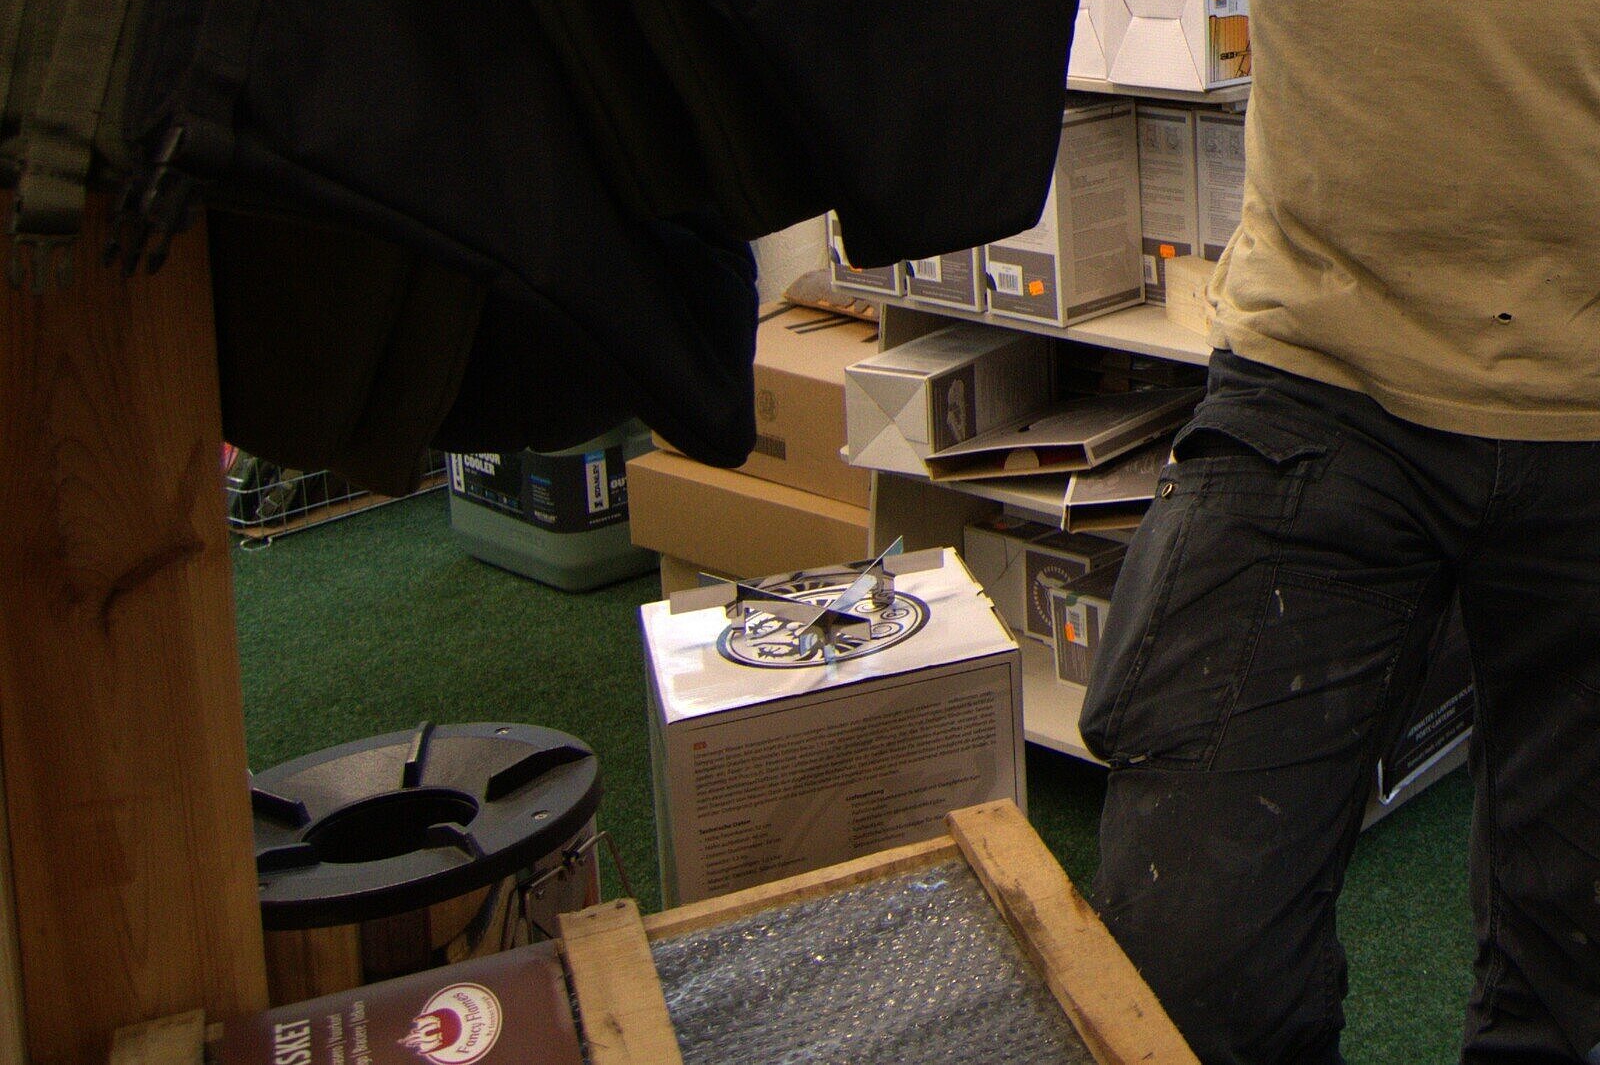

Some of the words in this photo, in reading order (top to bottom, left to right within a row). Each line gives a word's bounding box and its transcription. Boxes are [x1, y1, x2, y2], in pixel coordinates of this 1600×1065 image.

[464, 454, 496, 476] COOLER
[453, 991, 483, 1022] Flames
[456, 1019, 485, 1054] Fancy
